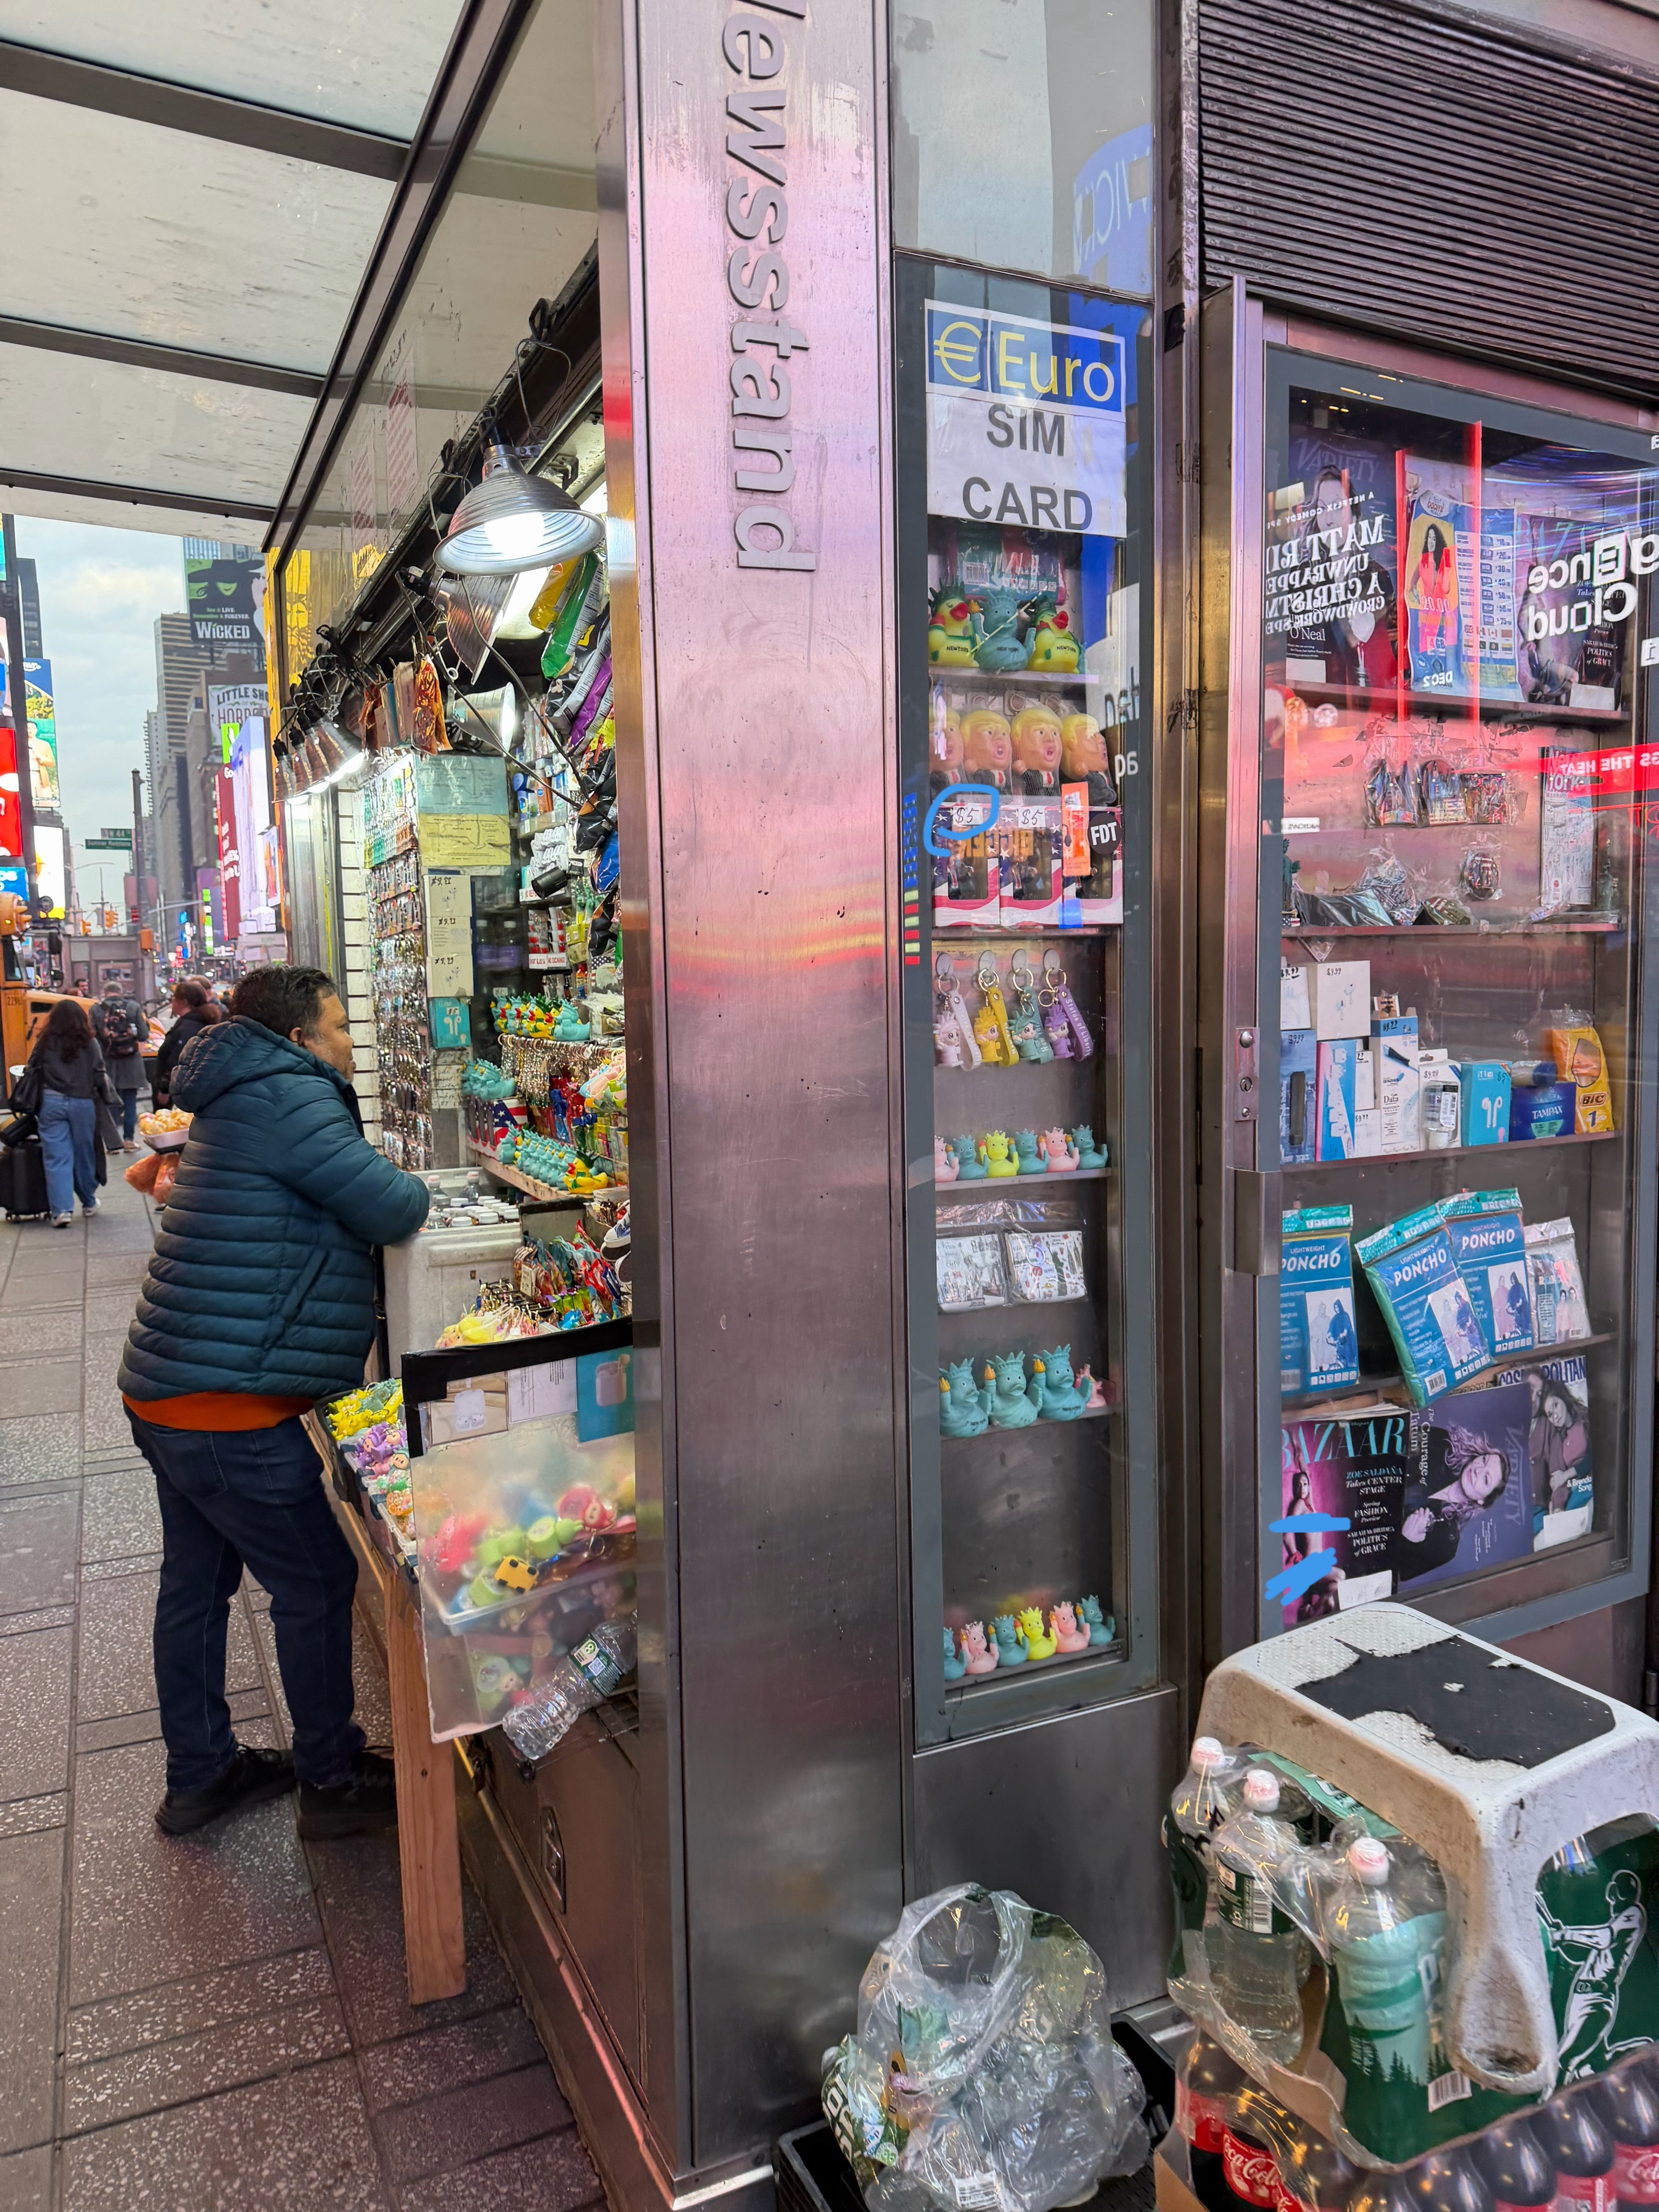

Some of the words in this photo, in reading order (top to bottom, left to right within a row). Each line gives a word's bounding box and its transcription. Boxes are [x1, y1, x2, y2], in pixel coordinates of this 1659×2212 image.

[722, 0, 817, 571] ewsstand
[999, 330, 1115, 403] Euro
[987, 403, 1065, 457] SIM
[962, 476, 1092, 531] CARD
[1289, 627, 1326, 641] O'Neal
[217, 687, 250, 706] LITTLE
[955, 807, 979, 824] $5
[1021, 808, 1043, 826] $5
[1090, 821, 1117, 846] FDT
[1066, 998, 1080, 1022] Statue
[1383, 1095, 1399, 1105] Data
[1581, 1095, 1605, 1105] BIC
[1532, 1105, 1563, 1121] TAMPAX
[1461, 1228, 1515, 1251] PONCHO
[1290, 1245, 1326, 1254] LIGHTWEIGHT
[1393, 1248, 1447, 1287] PONCHO
[1410, 1411, 1420, 1452] Tatum
[1419, 1421, 1431, 1475] Courage
[1346, 1479, 1366, 1488] Takes
[1366, 1476, 1402, 1486] CENTER
[1419, 1476, 1428, 1486] of
[1567, 1479, 1572, 1488] &
[1359, 1485, 1386, 1495] STAGE
[1354, 1506, 1388, 1518] FASHION
[1360, 1515, 1381, 1523] Preview
[1347, 1529, 1366, 1539] SARAH
[1353, 1534, 1388, 1547] POLITICS
[1360, 1543, 1386, 1555] GRACE
